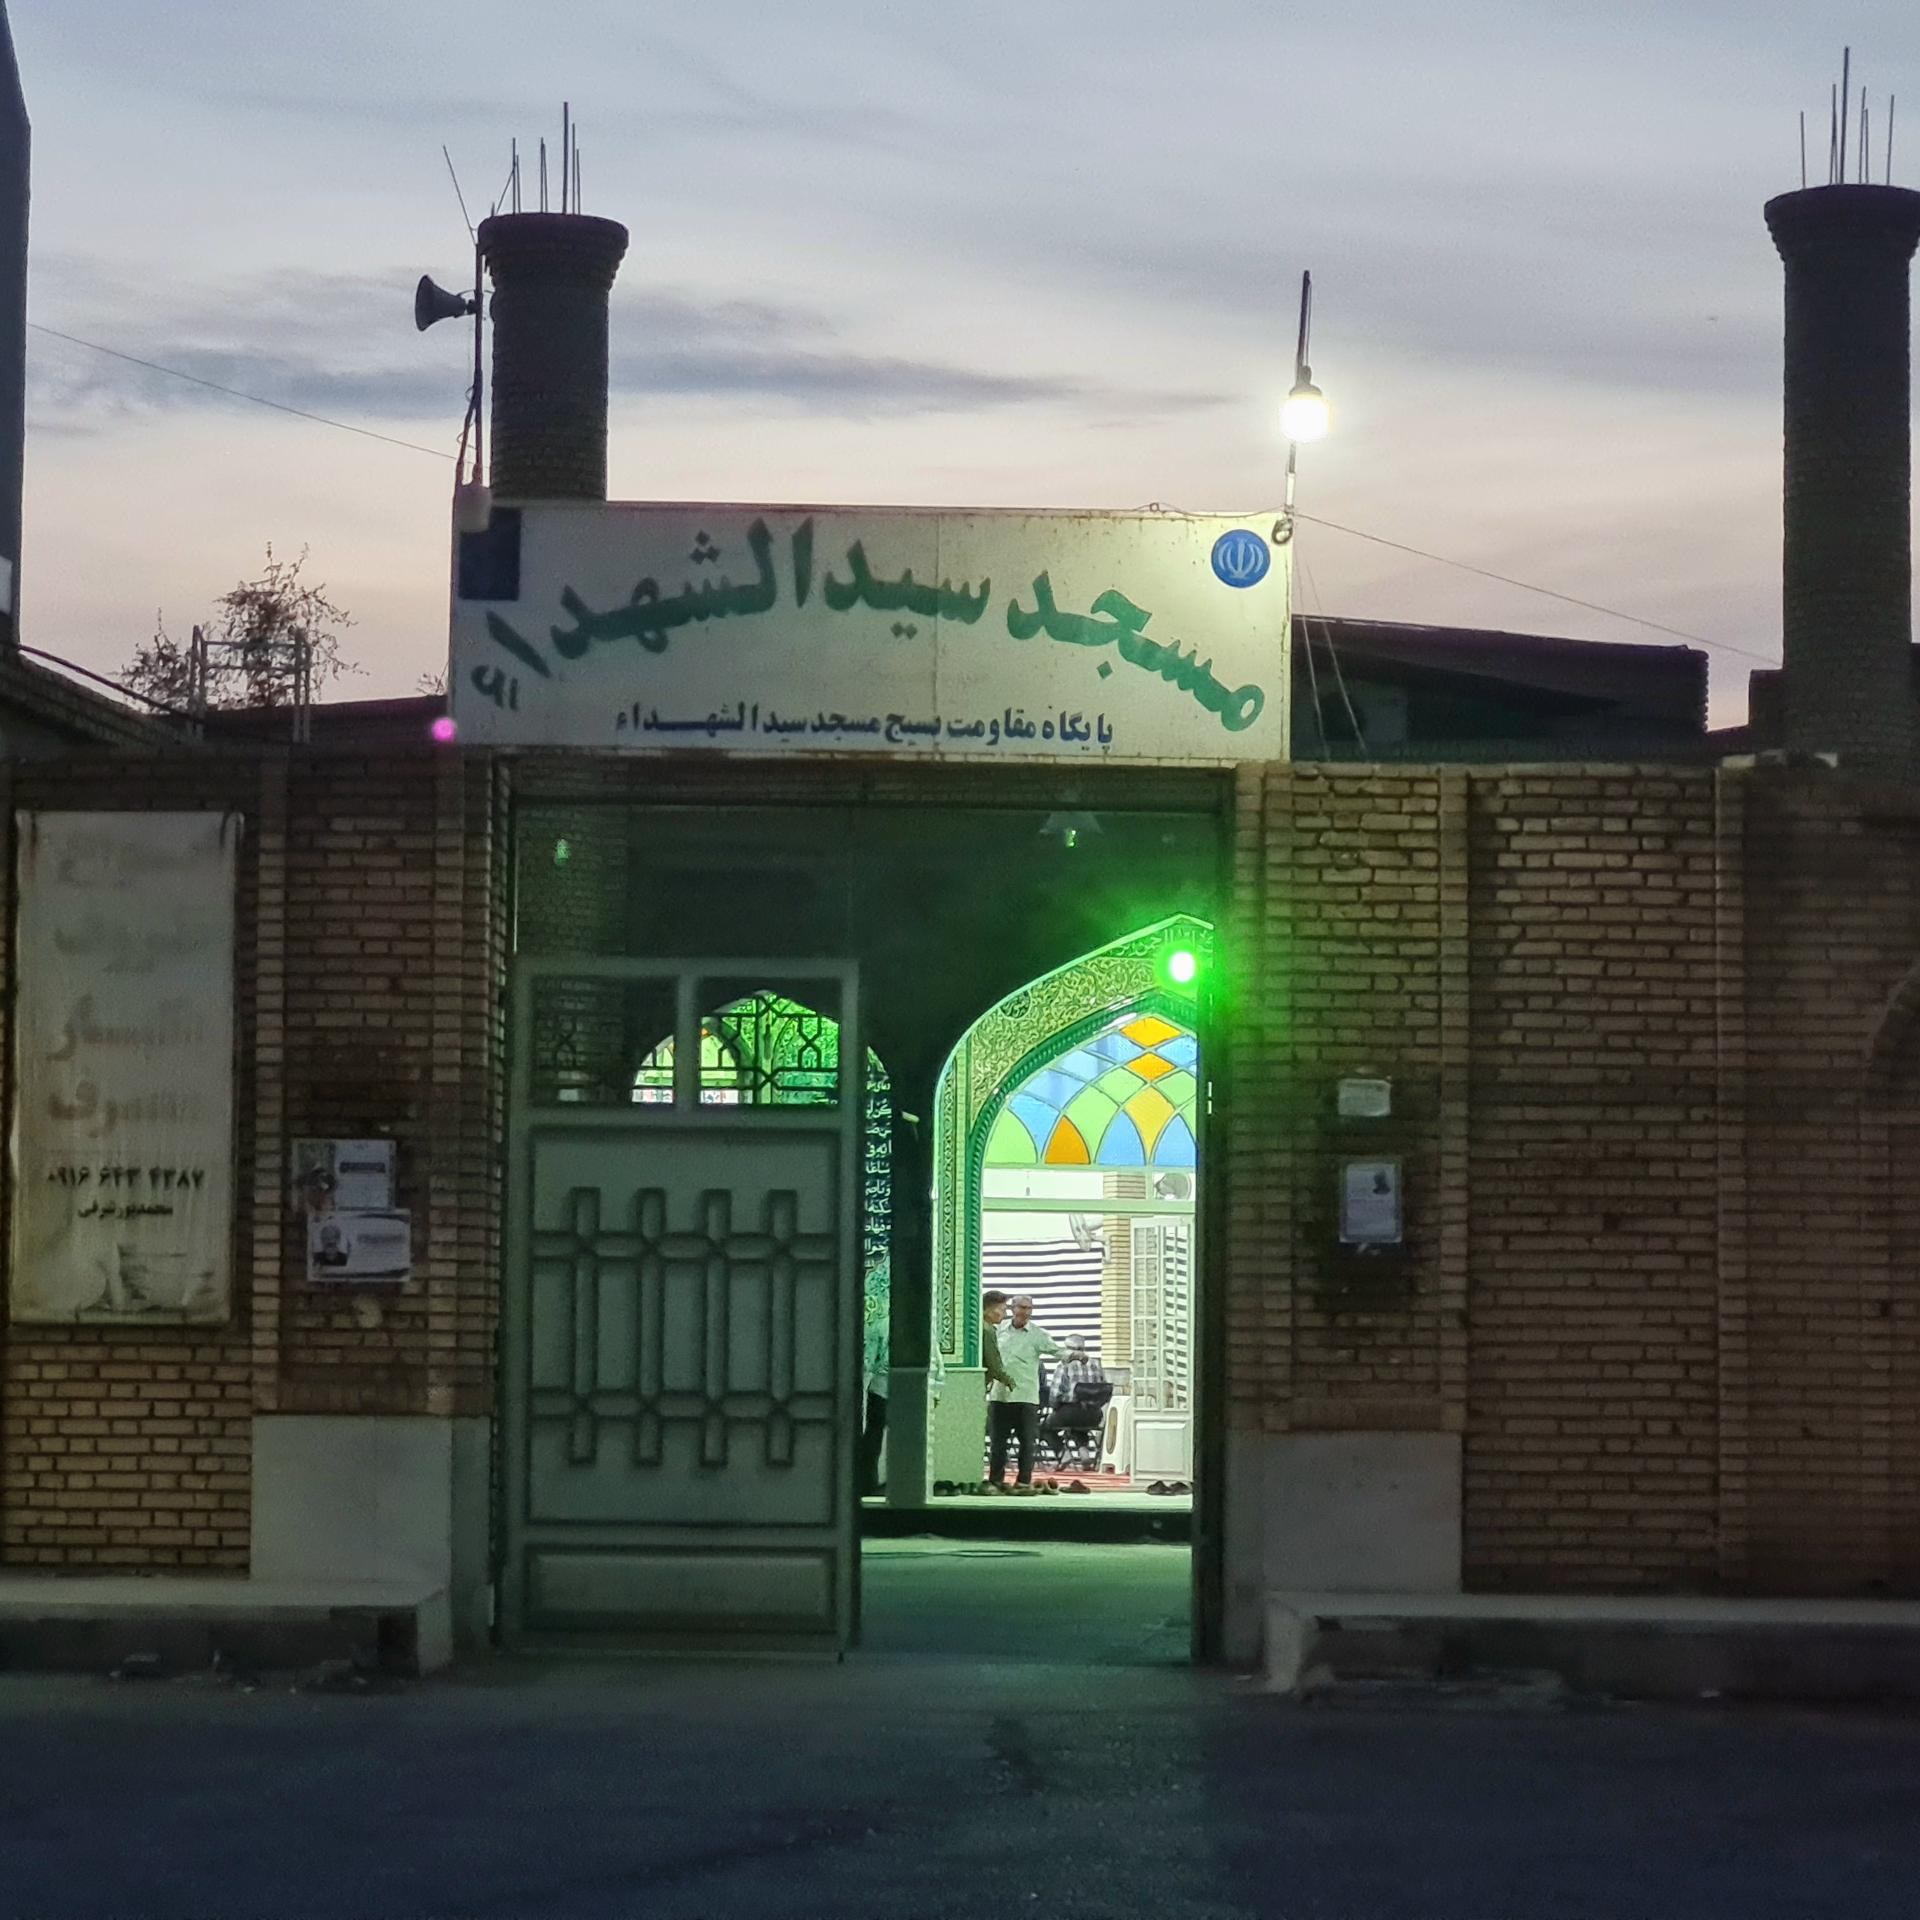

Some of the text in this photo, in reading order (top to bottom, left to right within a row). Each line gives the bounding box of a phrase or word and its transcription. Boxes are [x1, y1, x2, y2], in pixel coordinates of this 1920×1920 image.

[824, 538, 991, 642] سید
[1006, 570, 1265, 732] مسجد
[616, 701, 1114, 752] پایگاه مقاومت بسیج مسجد سید الشهداء
